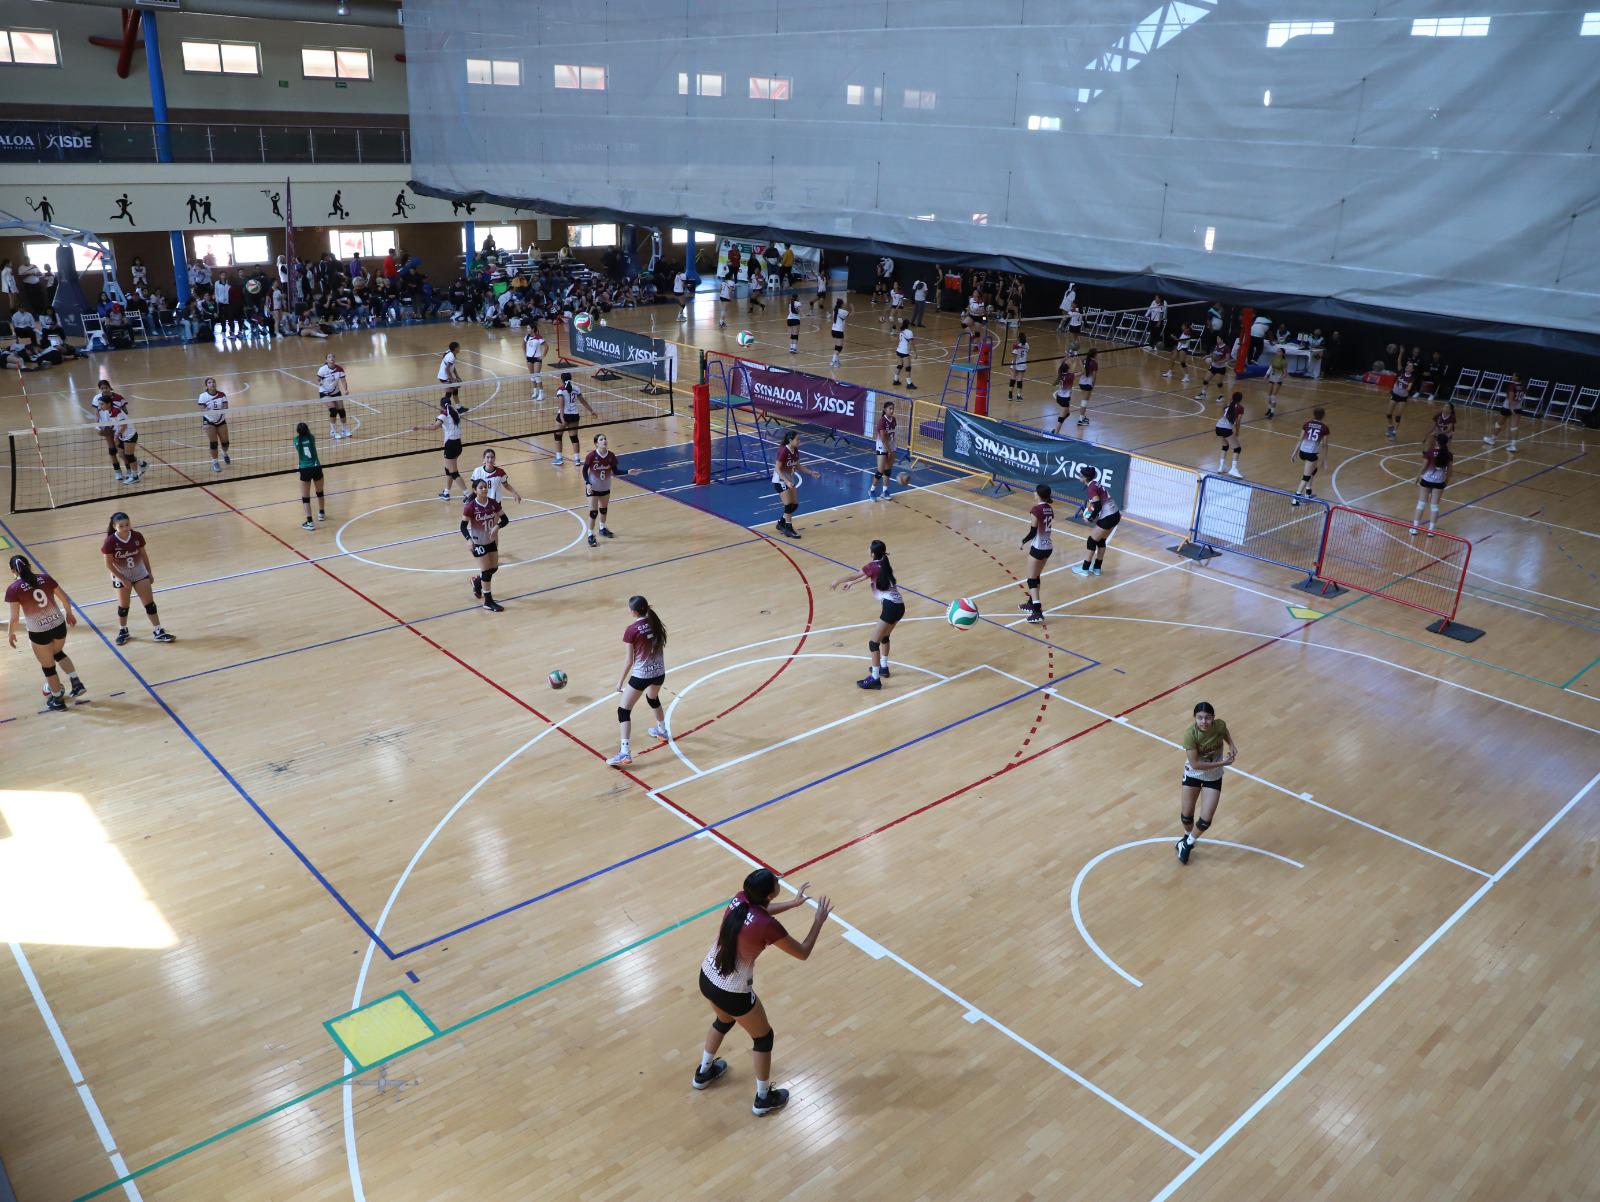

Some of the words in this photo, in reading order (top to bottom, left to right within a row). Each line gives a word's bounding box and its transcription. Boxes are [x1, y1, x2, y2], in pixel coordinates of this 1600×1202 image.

[59, 135, 92, 148] ISDE
[585, 336, 621, 356] SINALOA
[753, 382, 803, 404] SINALOA
[823, 396, 855, 417] ISDE
[1307, 428, 1320, 442] 15
[974, 436, 1040, 468] SINALOA
[600, 470, 606, 481] 6
[481, 519, 494, 532] 10
[1043, 515, 1053, 532] 12
[474, 545, 486, 556] 10
[127, 557, 135, 568] 8
[32, 588, 48, 608] 9
